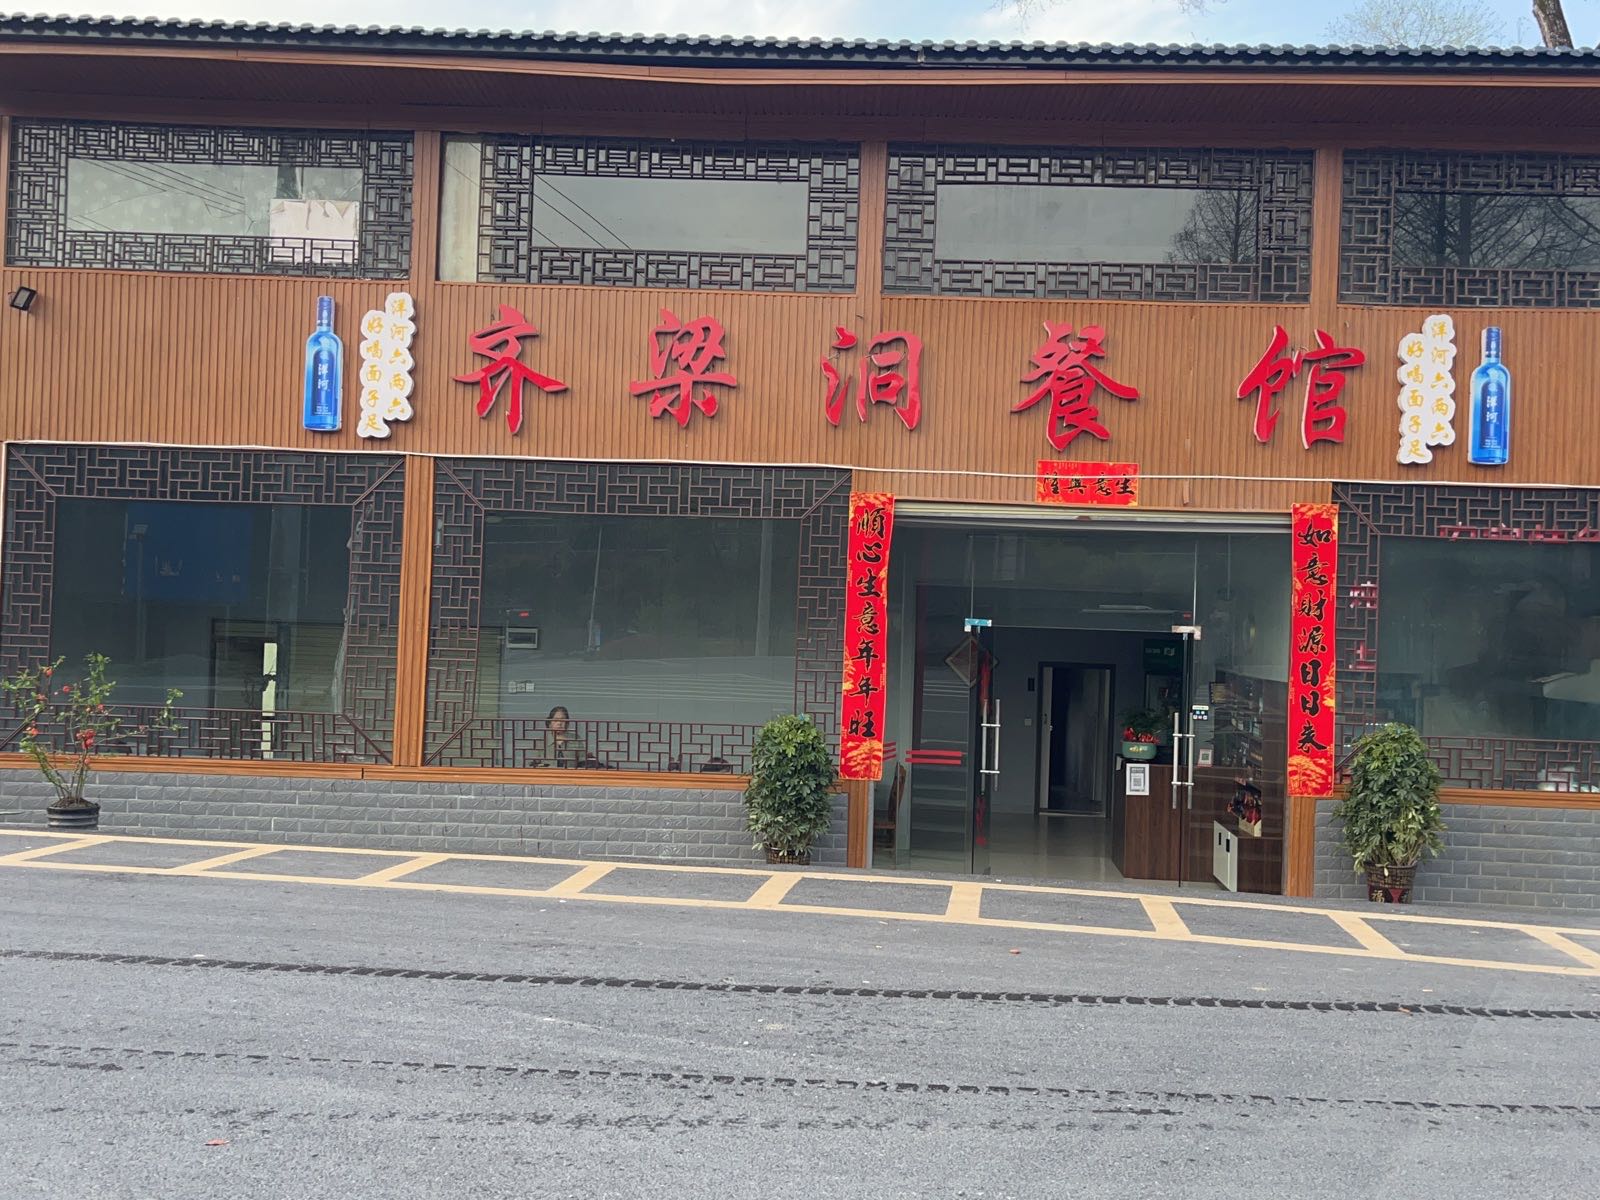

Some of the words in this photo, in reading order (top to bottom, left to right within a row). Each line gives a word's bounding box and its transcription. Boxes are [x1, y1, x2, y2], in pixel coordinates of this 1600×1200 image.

[453, 304, 1367, 452] 齐梁洞餐馆
